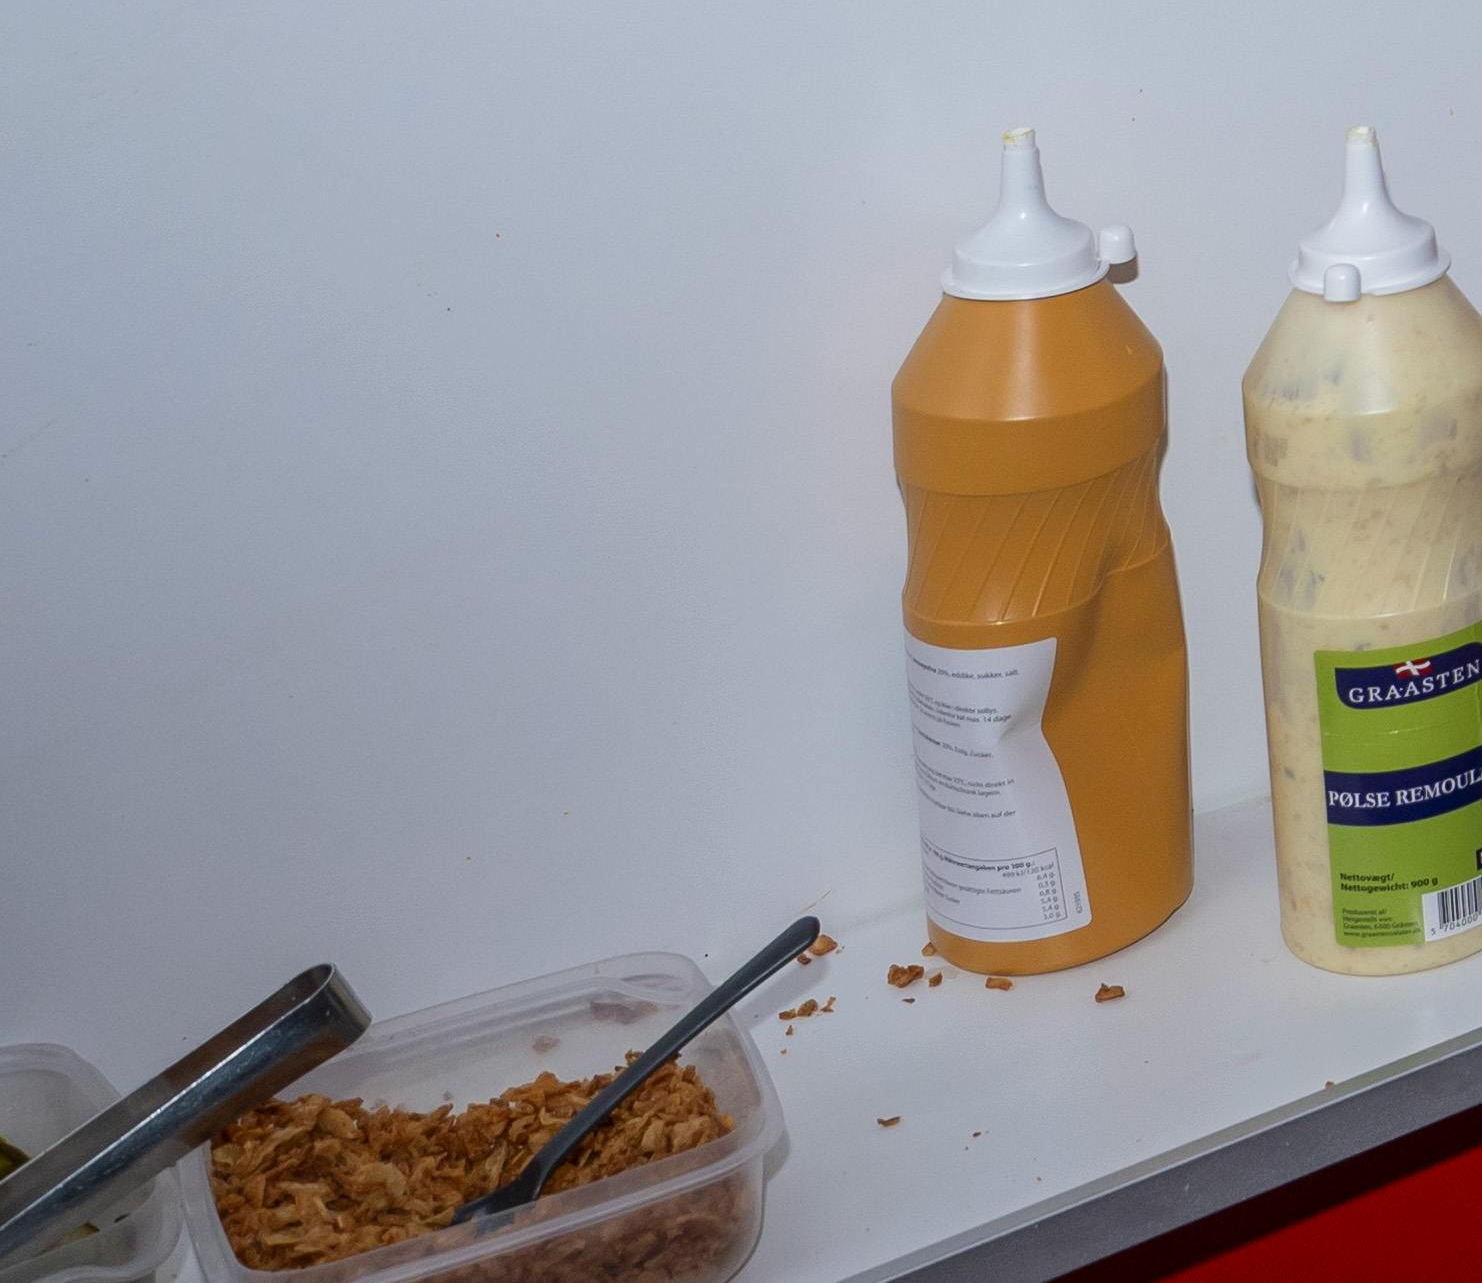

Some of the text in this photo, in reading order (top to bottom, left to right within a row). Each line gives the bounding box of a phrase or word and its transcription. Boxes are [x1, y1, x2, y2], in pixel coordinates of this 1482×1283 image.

[1327, 789, 1392, 809] PØLSE
[1410, 877, 1430, 888] 900
[1431, 876, 1439, 887] g
[1443, 913, 1479, 933] 704000
